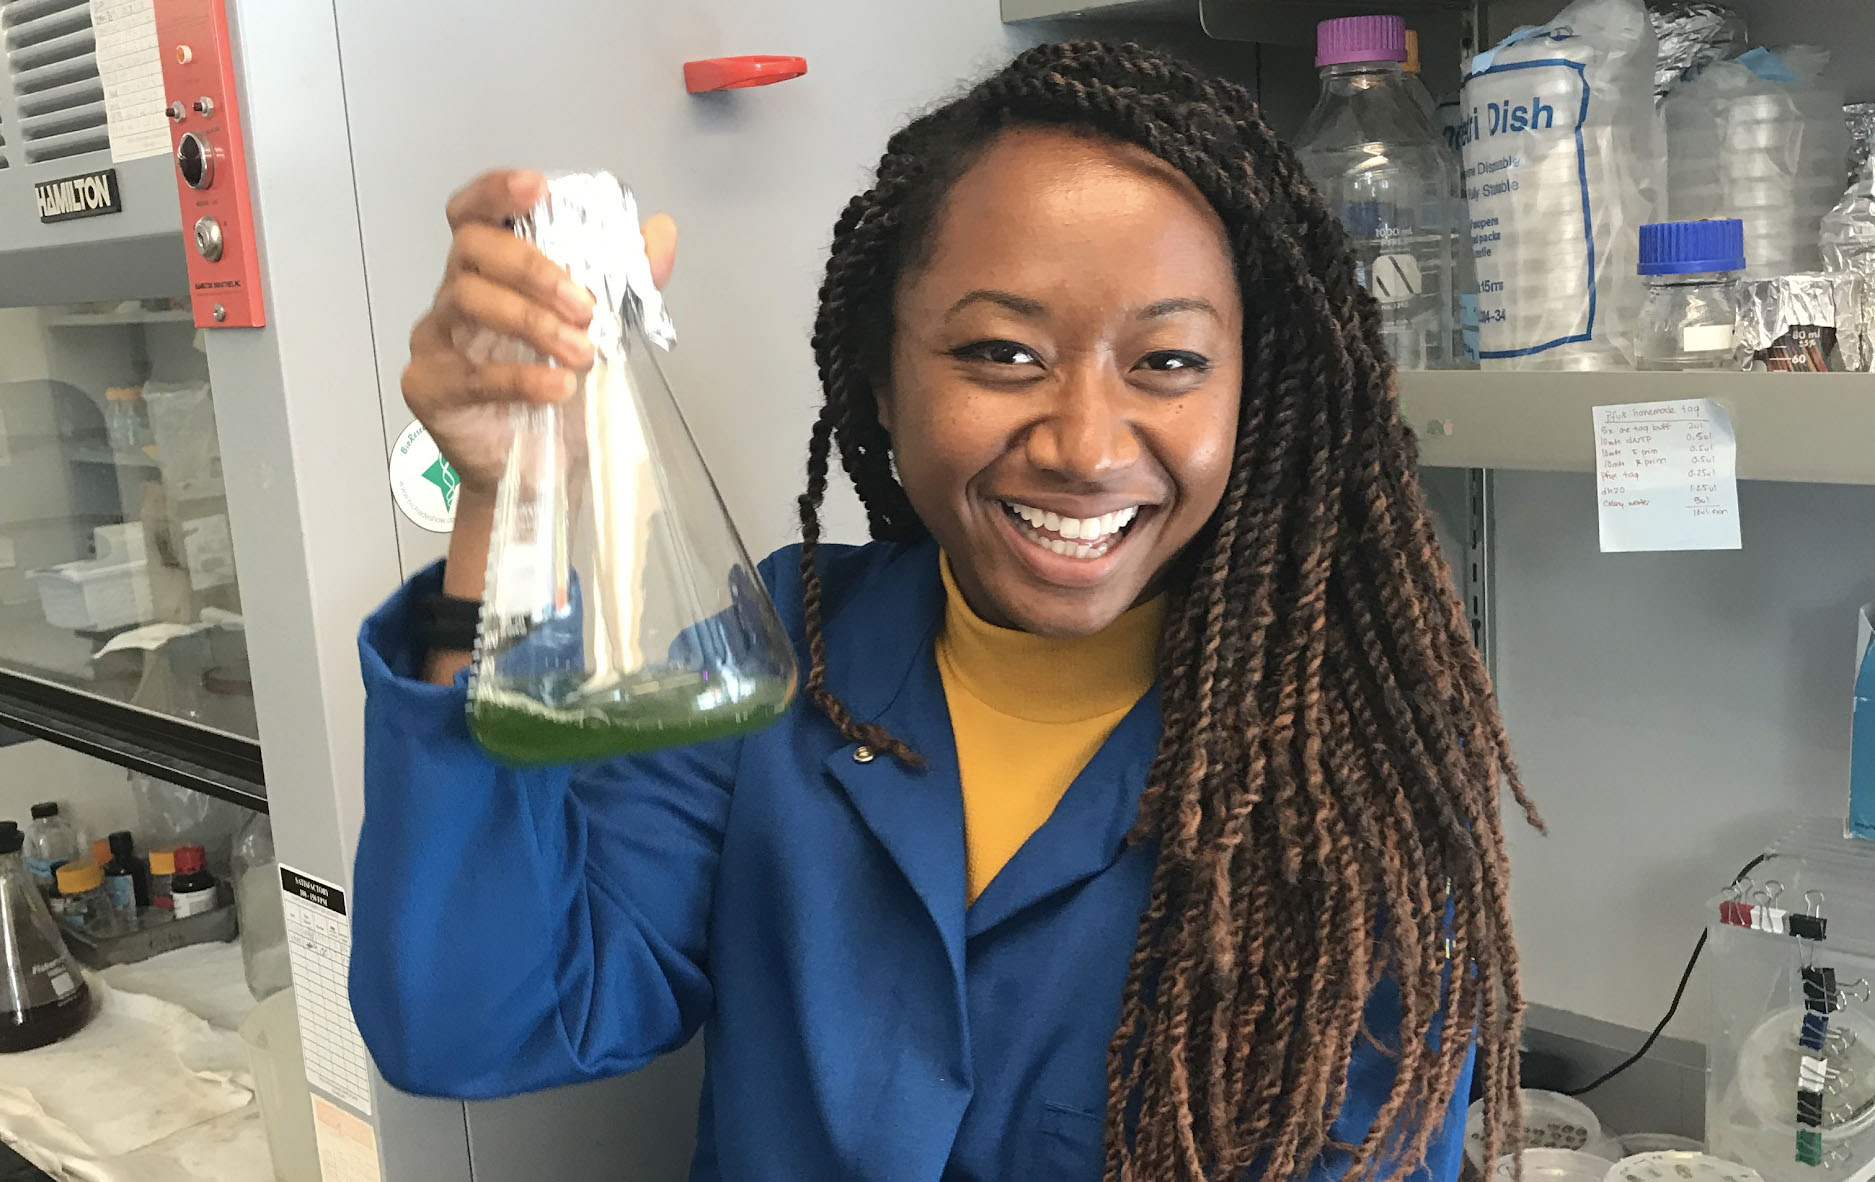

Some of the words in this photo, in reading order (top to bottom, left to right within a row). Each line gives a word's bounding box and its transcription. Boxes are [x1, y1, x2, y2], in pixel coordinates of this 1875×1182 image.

[1488, 97, 1554, 136] Dish
[35, 174, 111, 217] HAMILTON
[1792, 330, 1806, 340] 80
[1791, 354, 1806, 364] 60
[295, 876, 329, 897] SATISFACTORY
